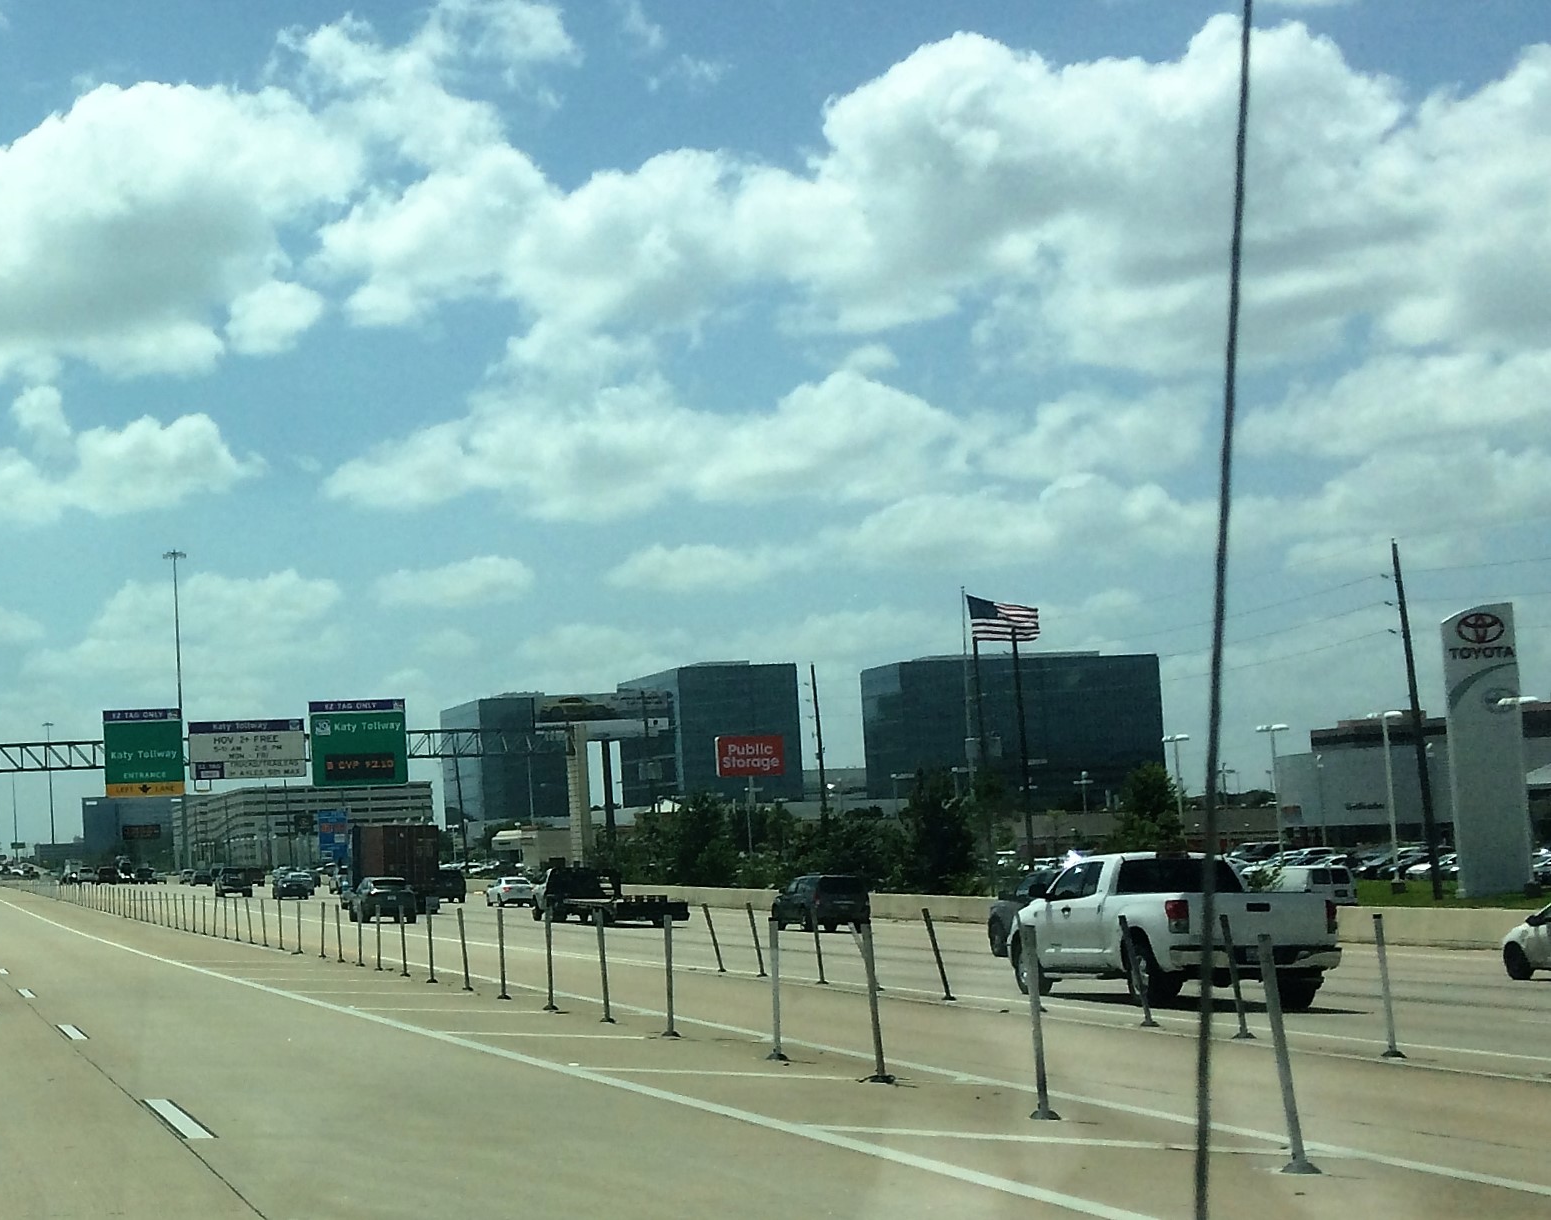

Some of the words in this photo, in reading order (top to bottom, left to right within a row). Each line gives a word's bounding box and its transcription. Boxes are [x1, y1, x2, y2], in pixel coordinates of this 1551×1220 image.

[1448, 646, 1516, 660] TOYOTA
[212, 723, 230, 731] Katy
[235, 722, 268, 730] Tollway
[334, 722, 357, 733] Katy
[361, 721, 401, 731] Tollway
[213, 736, 234, 744] HOV
[253, 734, 279, 743] FREE
[728, 743, 773, 755] Public
[111, 751, 134, 761] Katy
[137, 750, 177, 760] Tollway
[722, 756, 780, 771] Storage
[123, 771, 167, 779] ENTRANCE
